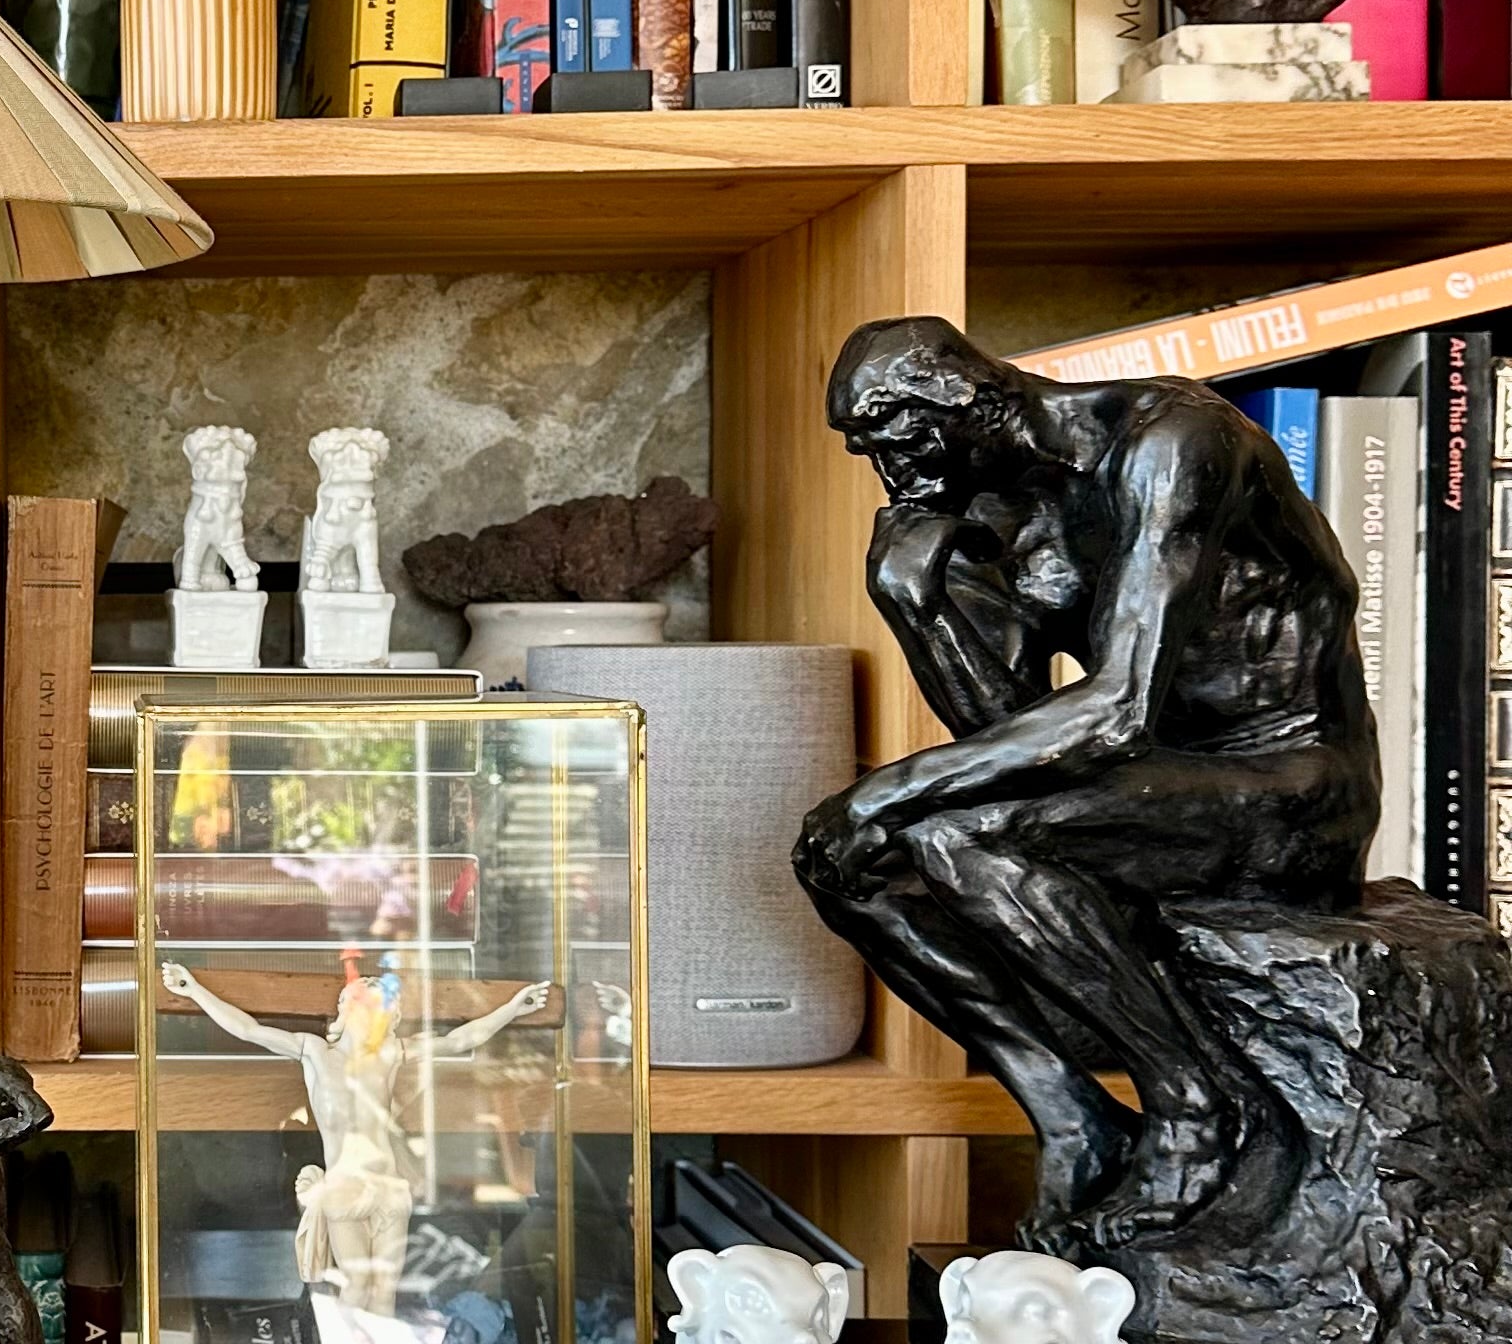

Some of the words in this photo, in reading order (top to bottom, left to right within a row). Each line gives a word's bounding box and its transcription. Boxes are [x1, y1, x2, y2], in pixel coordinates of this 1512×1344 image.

[384, 10, 396, 52] MARIA
[1153, 328, 1197, 376] LA
[1208, 302, 1308, 362] FELLINI
[1448, 336, 1467, 366] Art
[1448, 373, 1462, 395] of
[1447, 402, 1469, 435] This
[1361, 435, 1386, 543] 1904-1917
[1444, 436, 1468, 513] Century
[1359, 547, 1385, 635] Matisse
[39, 667, 58, 724] L'ART
[37, 727, 56, 752] DE
[33, 755, 54, 893] PSYCHOLOGIE
